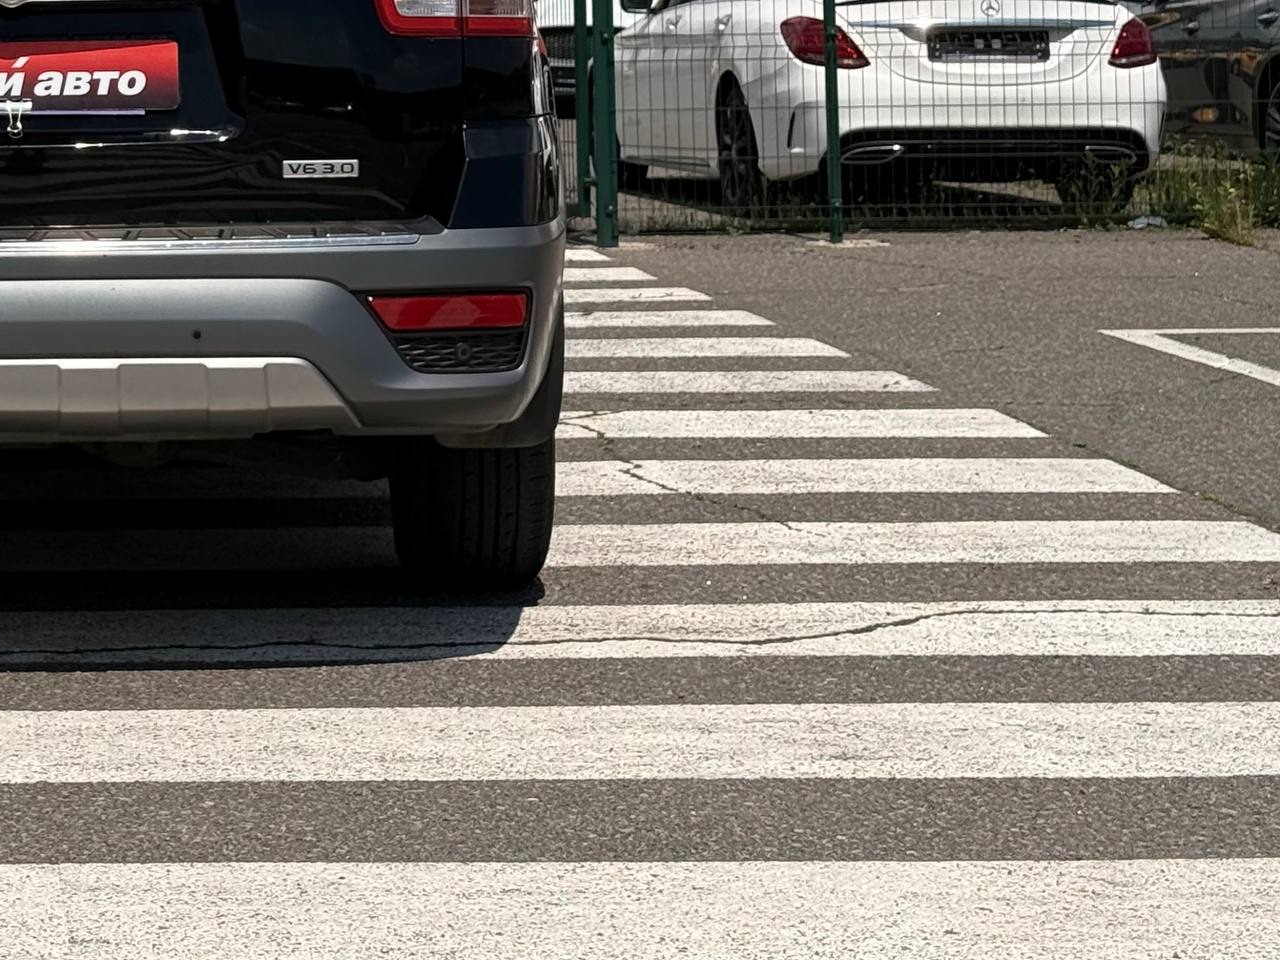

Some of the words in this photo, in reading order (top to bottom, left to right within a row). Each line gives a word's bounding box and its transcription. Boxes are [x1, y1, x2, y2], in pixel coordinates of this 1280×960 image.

[33, 70, 147, 96] авто
[288, 163, 317, 175] V6
[322, 163, 354, 175] 3.0
